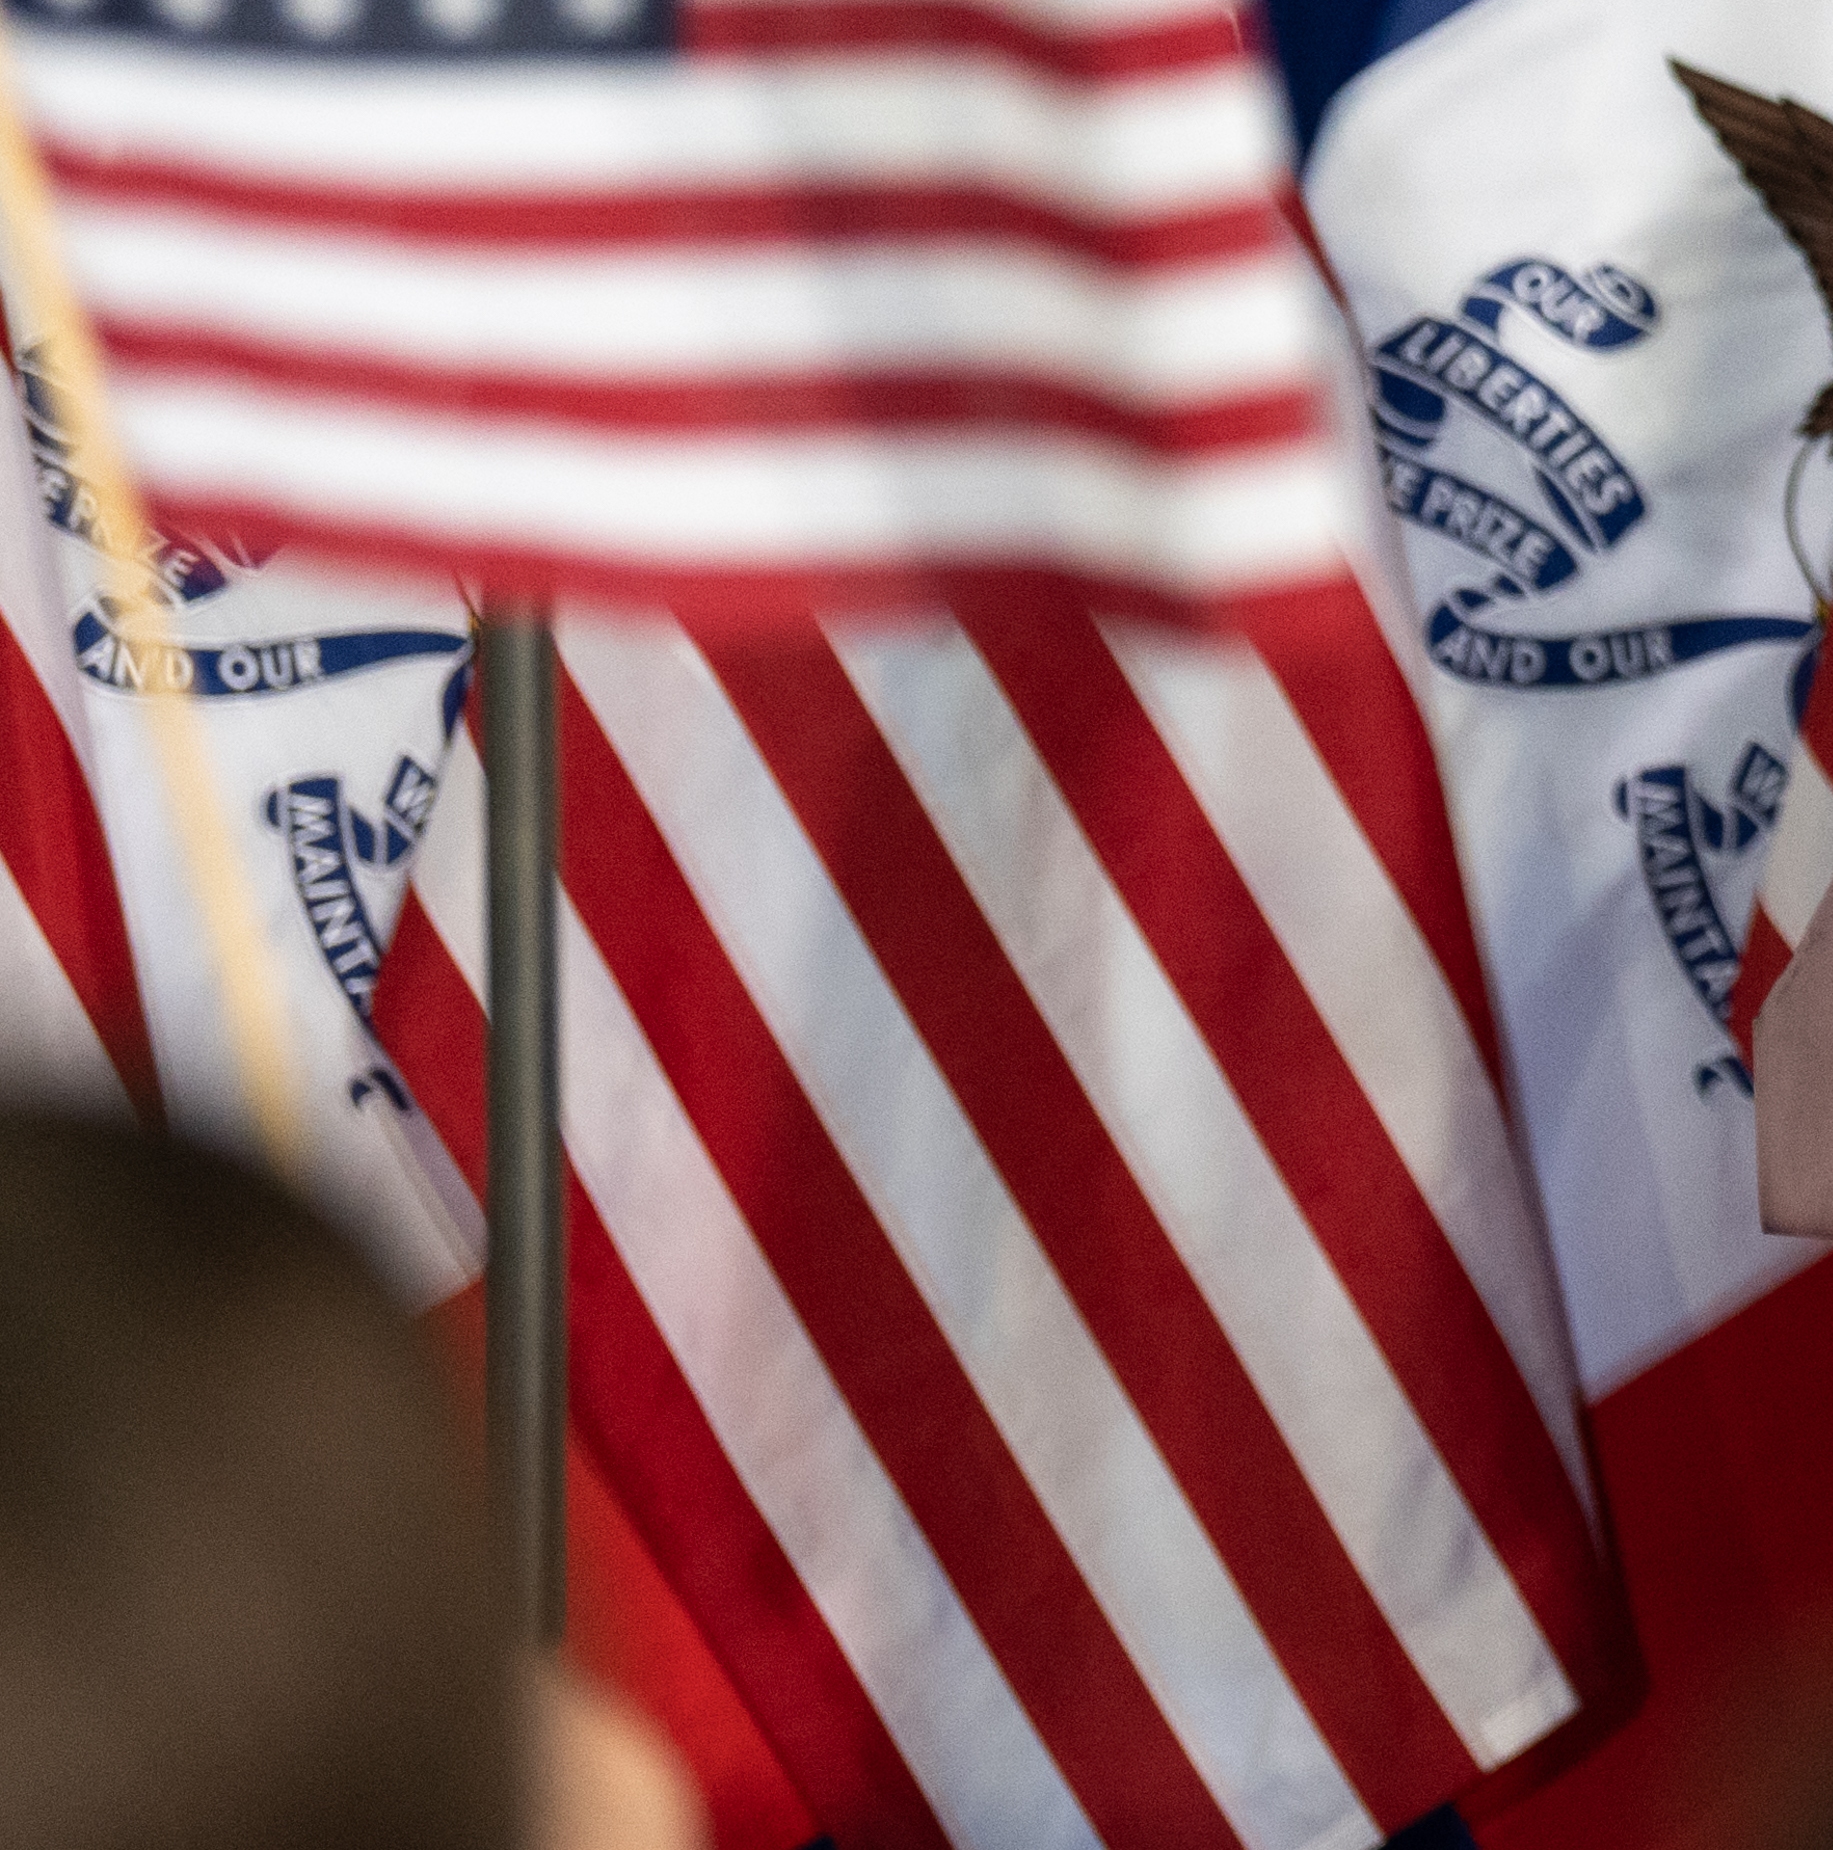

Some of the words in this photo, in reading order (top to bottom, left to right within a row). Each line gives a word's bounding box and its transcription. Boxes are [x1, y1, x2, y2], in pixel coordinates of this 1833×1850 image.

[1511, 262, 1606, 342] OUR
[1401, 323, 1635, 516] LIBERTIES
[1420, 478, 1550, 581] PRIZE
[79, 635, 197, 692] AND
[217, 637, 322, 693] OUR
[1430, 625, 1547, 685] AND
[1567, 628, 1673, 684] OUR
[289, 793, 378, 998] MAINT
[1636, 782, 1738, 1016] MAINTA
